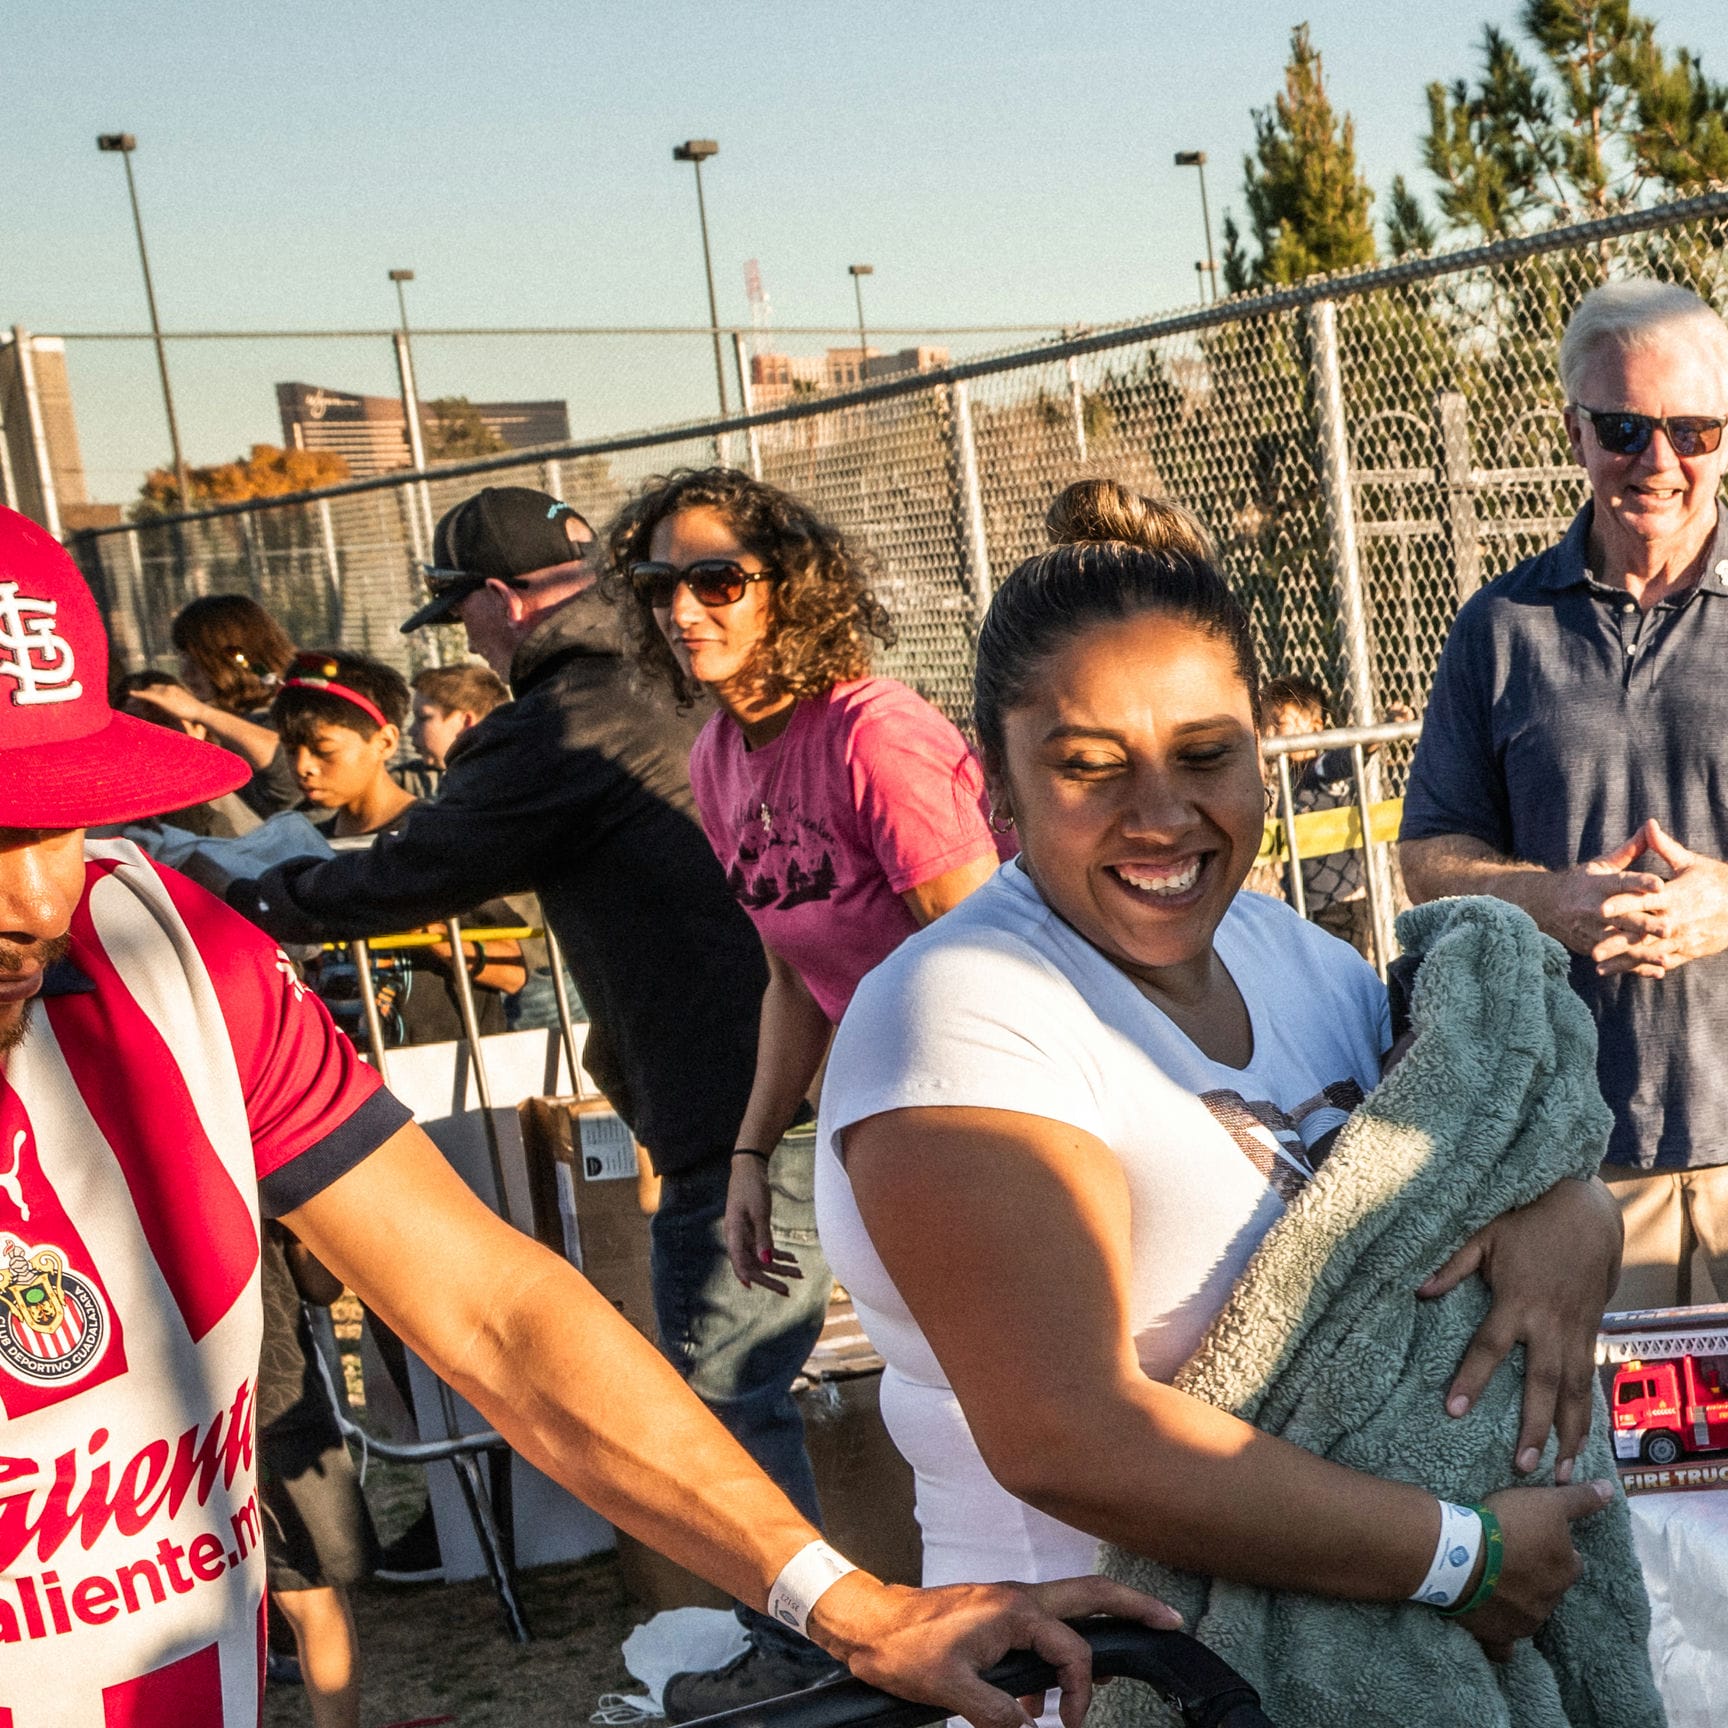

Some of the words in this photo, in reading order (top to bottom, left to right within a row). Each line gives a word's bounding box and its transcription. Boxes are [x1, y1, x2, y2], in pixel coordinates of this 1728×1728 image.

[8, 1346, 72, 1373] DEPORTIVO
[72, 1286, 99, 1364] GUADALAJARA
[1623, 1472, 1673, 1490] FIRE
